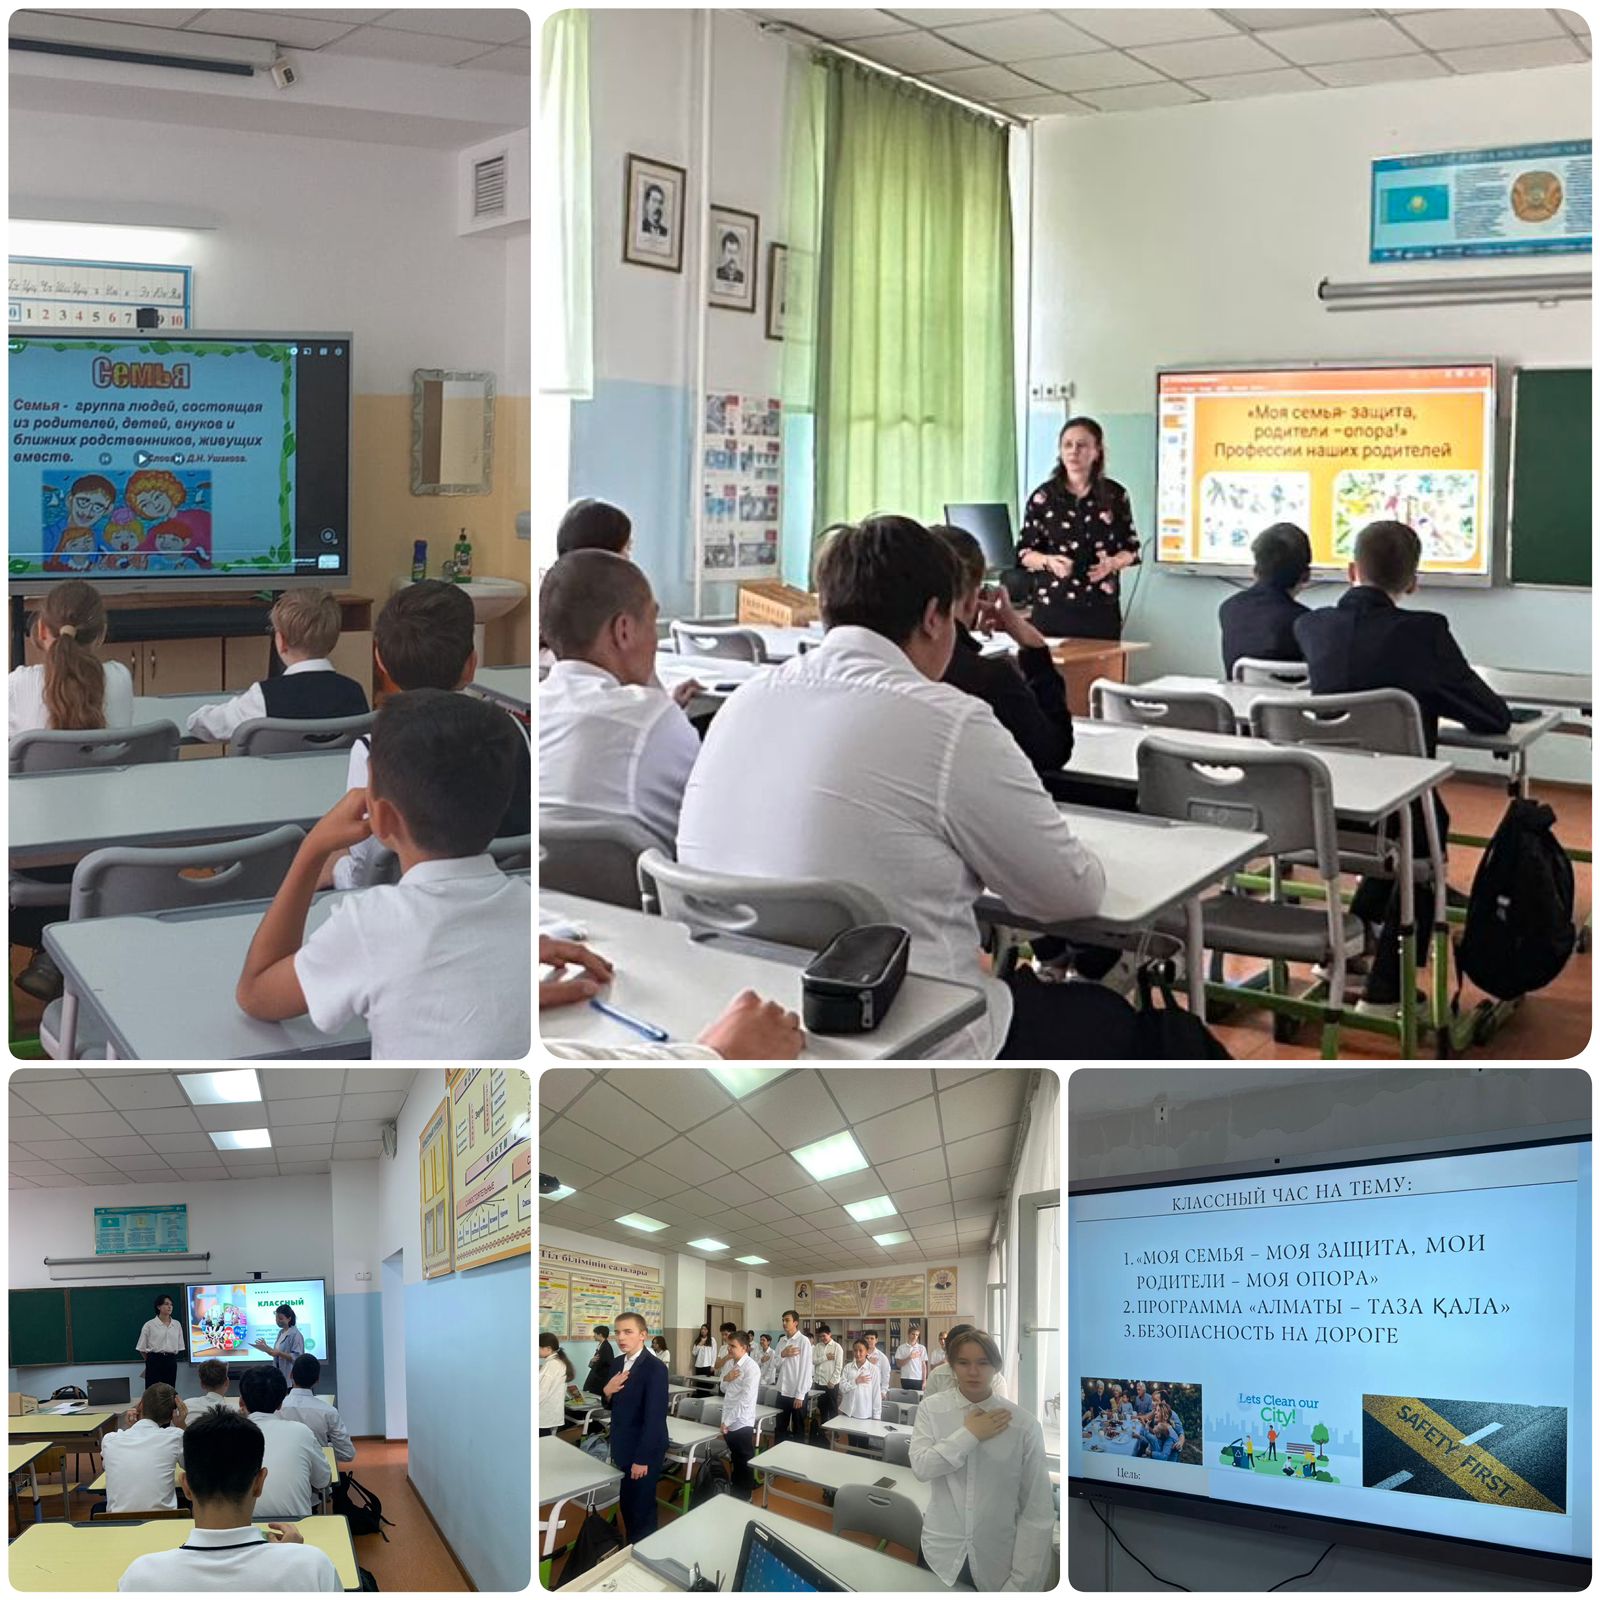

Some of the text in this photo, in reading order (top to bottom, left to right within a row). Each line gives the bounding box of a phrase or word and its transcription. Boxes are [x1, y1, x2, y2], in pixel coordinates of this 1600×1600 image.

[26, 308, 32, 319] 1
[42, 309, 50, 320] 2
[59, 310, 67, 320] 3
[75, 310, 83, 321] 4
[92, 311, 100, 322] 5
[109, 312, 116, 323] 6
[125, 313, 132, 323] 7
[171, 315, 183, 326] 10
[92, 356, 191, 389] Семья
[13, 399, 60, 411] Семья
[75, 402, 125, 414] группа
[128, 400, 179, 415] людей,
[182, 402, 263, 414] состоящая
[1248, 405, 1288, 420] «Моя
[1351, 405, 1417, 421] защита,
[13, 417, 235, 432] из родителей, детей, внуков и
[1254, 424, 1329, 440] родители
[13, 433, 262, 450] ближних родственников, живущих
[1214, 440, 1451, 460] Профессии наших родителей
[13, 452, 74, 463] вместе.
[1172, 1176, 1413, 1211] КЛАССНЫЙ ЧАС НА ТЕМУ:
[1185, 1246, 1244, 1263] СЕМЬЯ
[1266, 1243, 1310, 1260] МОЯ
[1317, 1238, 1416, 1263] ЗАЩИТА,
[1425, 1234, 1486, 1254] МОИ
[1136, 1273, 1225, 1291] РОДИТЕЛИ
[1246, 1272, 1289, 1288] МОЯ
[1296, 1269, 1378, 1287] ОПОРА»
[257, 1297, 305, 1307] КЛАССНЫЙ
[1137, 1299, 1243, 1314] ПРОГРАММА
[1249, 1299, 1343, 1315] «АЛМАТЫ
[1367, 1298, 1424, 1315] ТАЗА
[1433, 1297, 1511, 1318] ҚАЛА»
[1137, 1324, 1275, 1341] БЕЗОПАСНОСТЬ
[1282, 1326, 1309, 1342] НА
[1315, 1326, 1399, 1344] ДОРОГЕ
[1239, 1393, 1320, 1409] Lets Clean our
[1260, 1407, 1296, 1427] City!
[1397, 1405, 1516, 1499] SAFETY FIRST
[1117, 1466, 1141, 1480] Цель:
